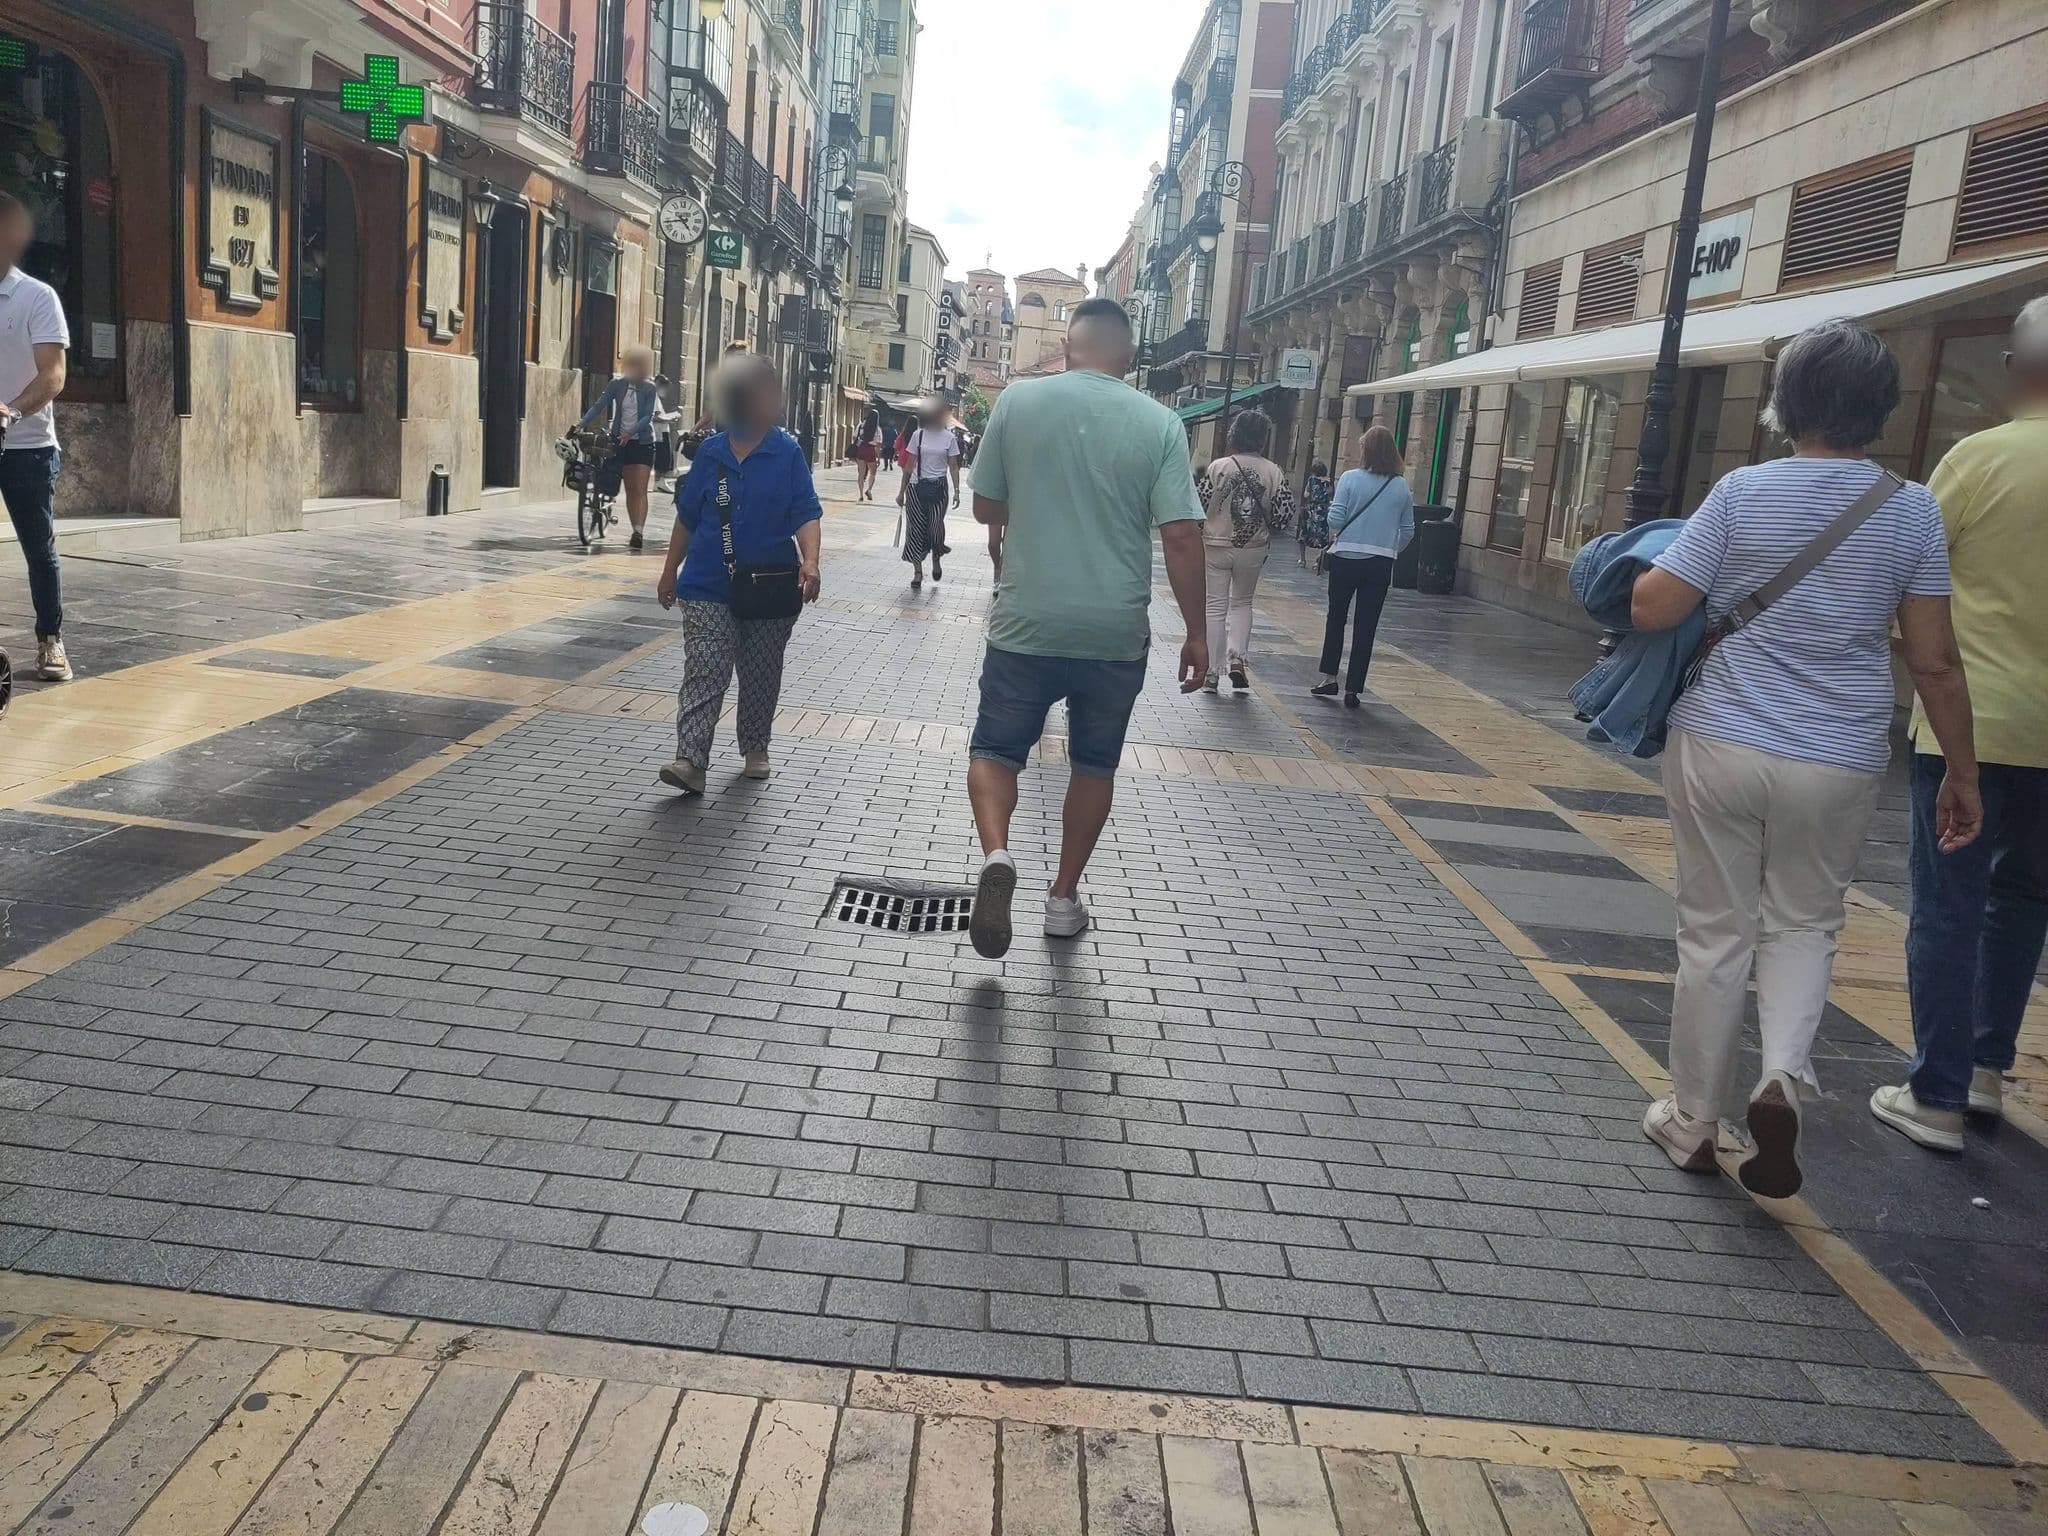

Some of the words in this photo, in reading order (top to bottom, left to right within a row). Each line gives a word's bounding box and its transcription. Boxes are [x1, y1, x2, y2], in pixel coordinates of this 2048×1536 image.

[211, 156, 273, 200] FUNDADA
[234, 205, 249, 227] EN
[722, 523, 734, 555] BIMBA
